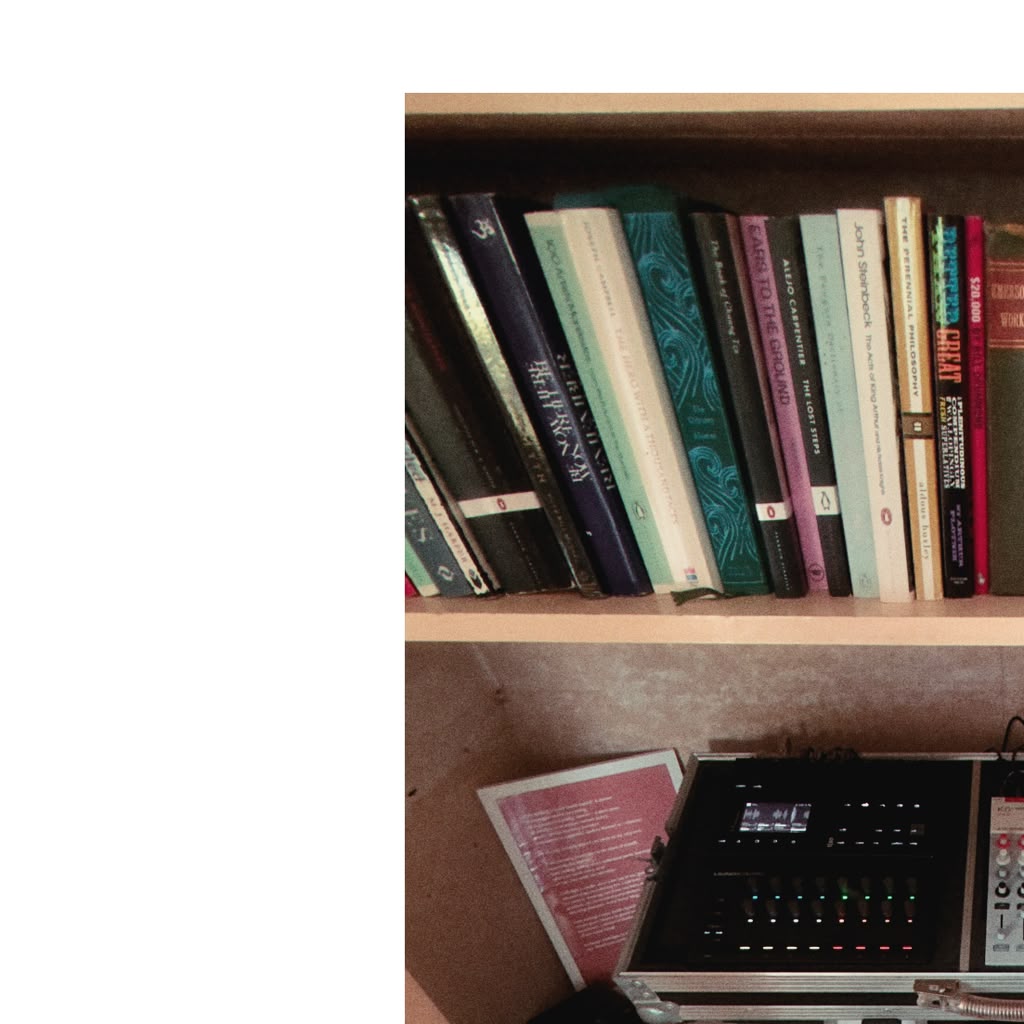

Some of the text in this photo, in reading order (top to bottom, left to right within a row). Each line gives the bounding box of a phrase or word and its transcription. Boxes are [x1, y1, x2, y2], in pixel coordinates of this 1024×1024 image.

[746, 223, 792, 405] EARS TO THE GROUND
[781, 258, 806, 365] ALEJO CARPENTIER
[852, 221, 874, 328] John Steinbeck
[900, 217, 919, 397] THE PERENNIAL PHILOSOPHY
[969, 277, 981, 322] $20,000
[865, 334, 873, 350] The
[935, 327, 962, 383] GREAT
[801, 379, 821, 455] THE LOST STEPS
[938, 396, 950, 488] FRESH SUPERLATIVES
[951, 396, 960, 488] COMPENDIUM
[957, 401, 965, 489] PLENITUDINOUS
[918, 481, 930, 560] aldous huxley
